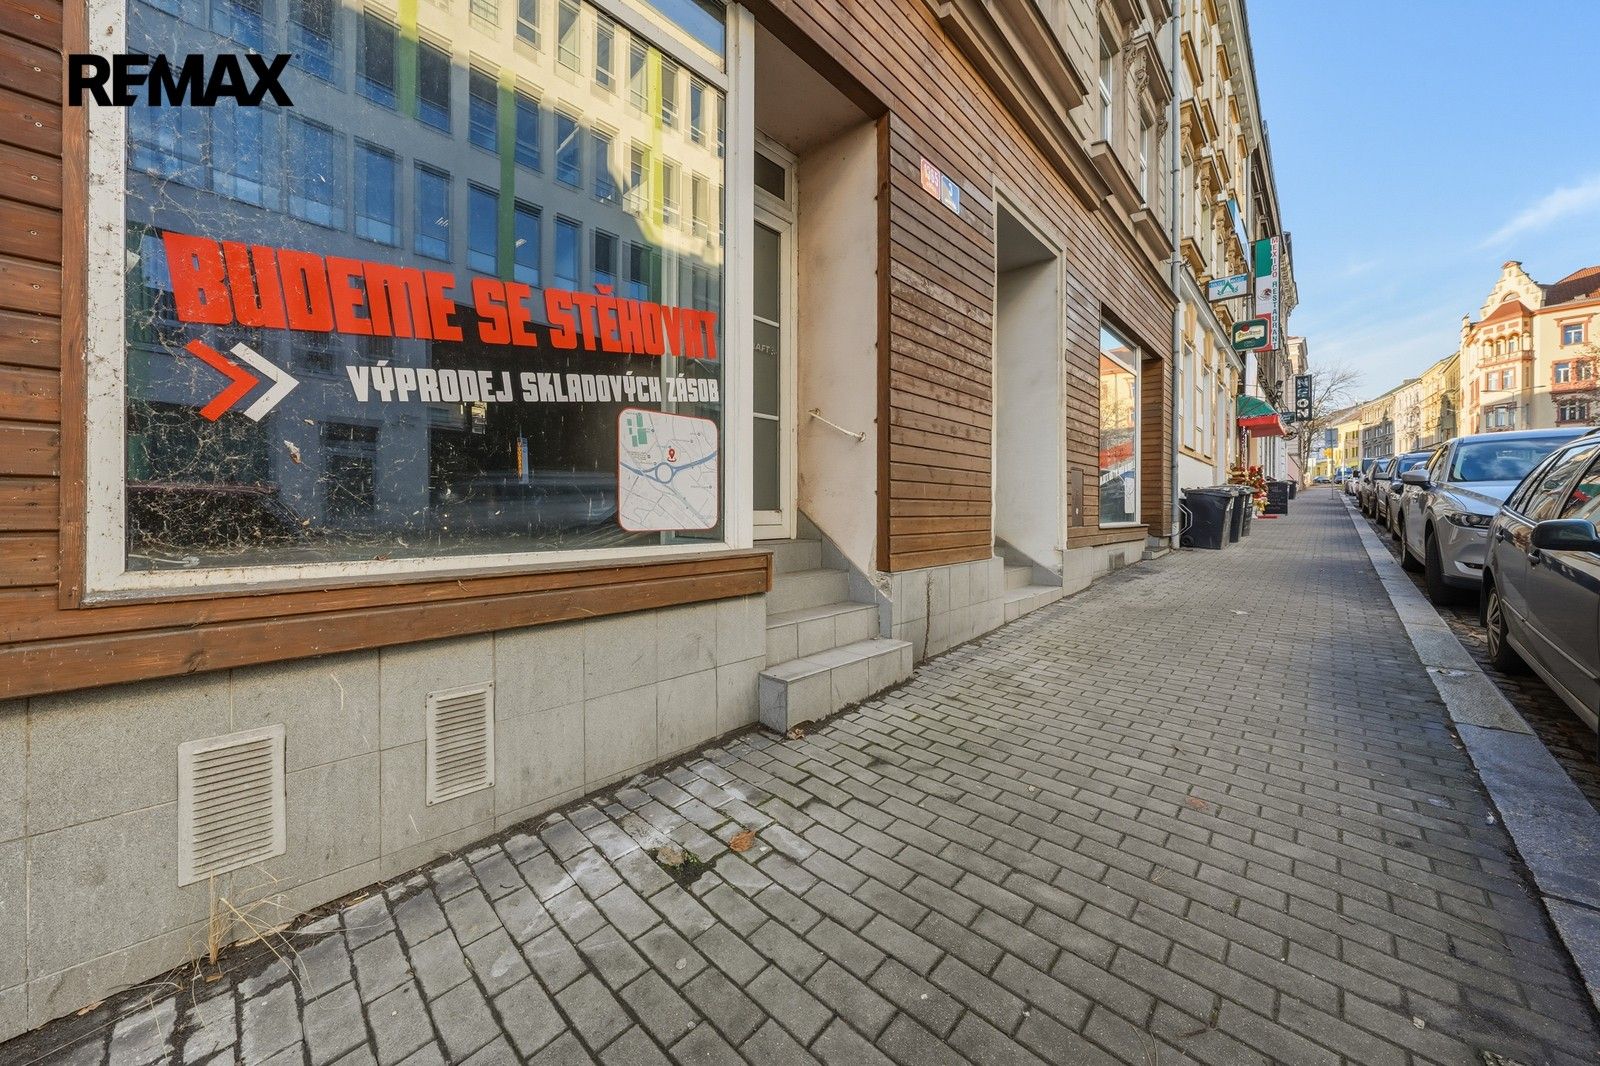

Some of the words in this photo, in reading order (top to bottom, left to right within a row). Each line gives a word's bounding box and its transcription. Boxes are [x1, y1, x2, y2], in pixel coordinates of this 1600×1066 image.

[162, 231, 464, 342] BUDEME
[471, 278, 538, 347] SE
[544, 283, 718, 360] STĚHOVAT
[346, 360, 514, 402] VÝPRODEJ
[520, 370, 662, 402] SKLADOVÝCH
[665, 372, 720, 402] ZÁSOB
